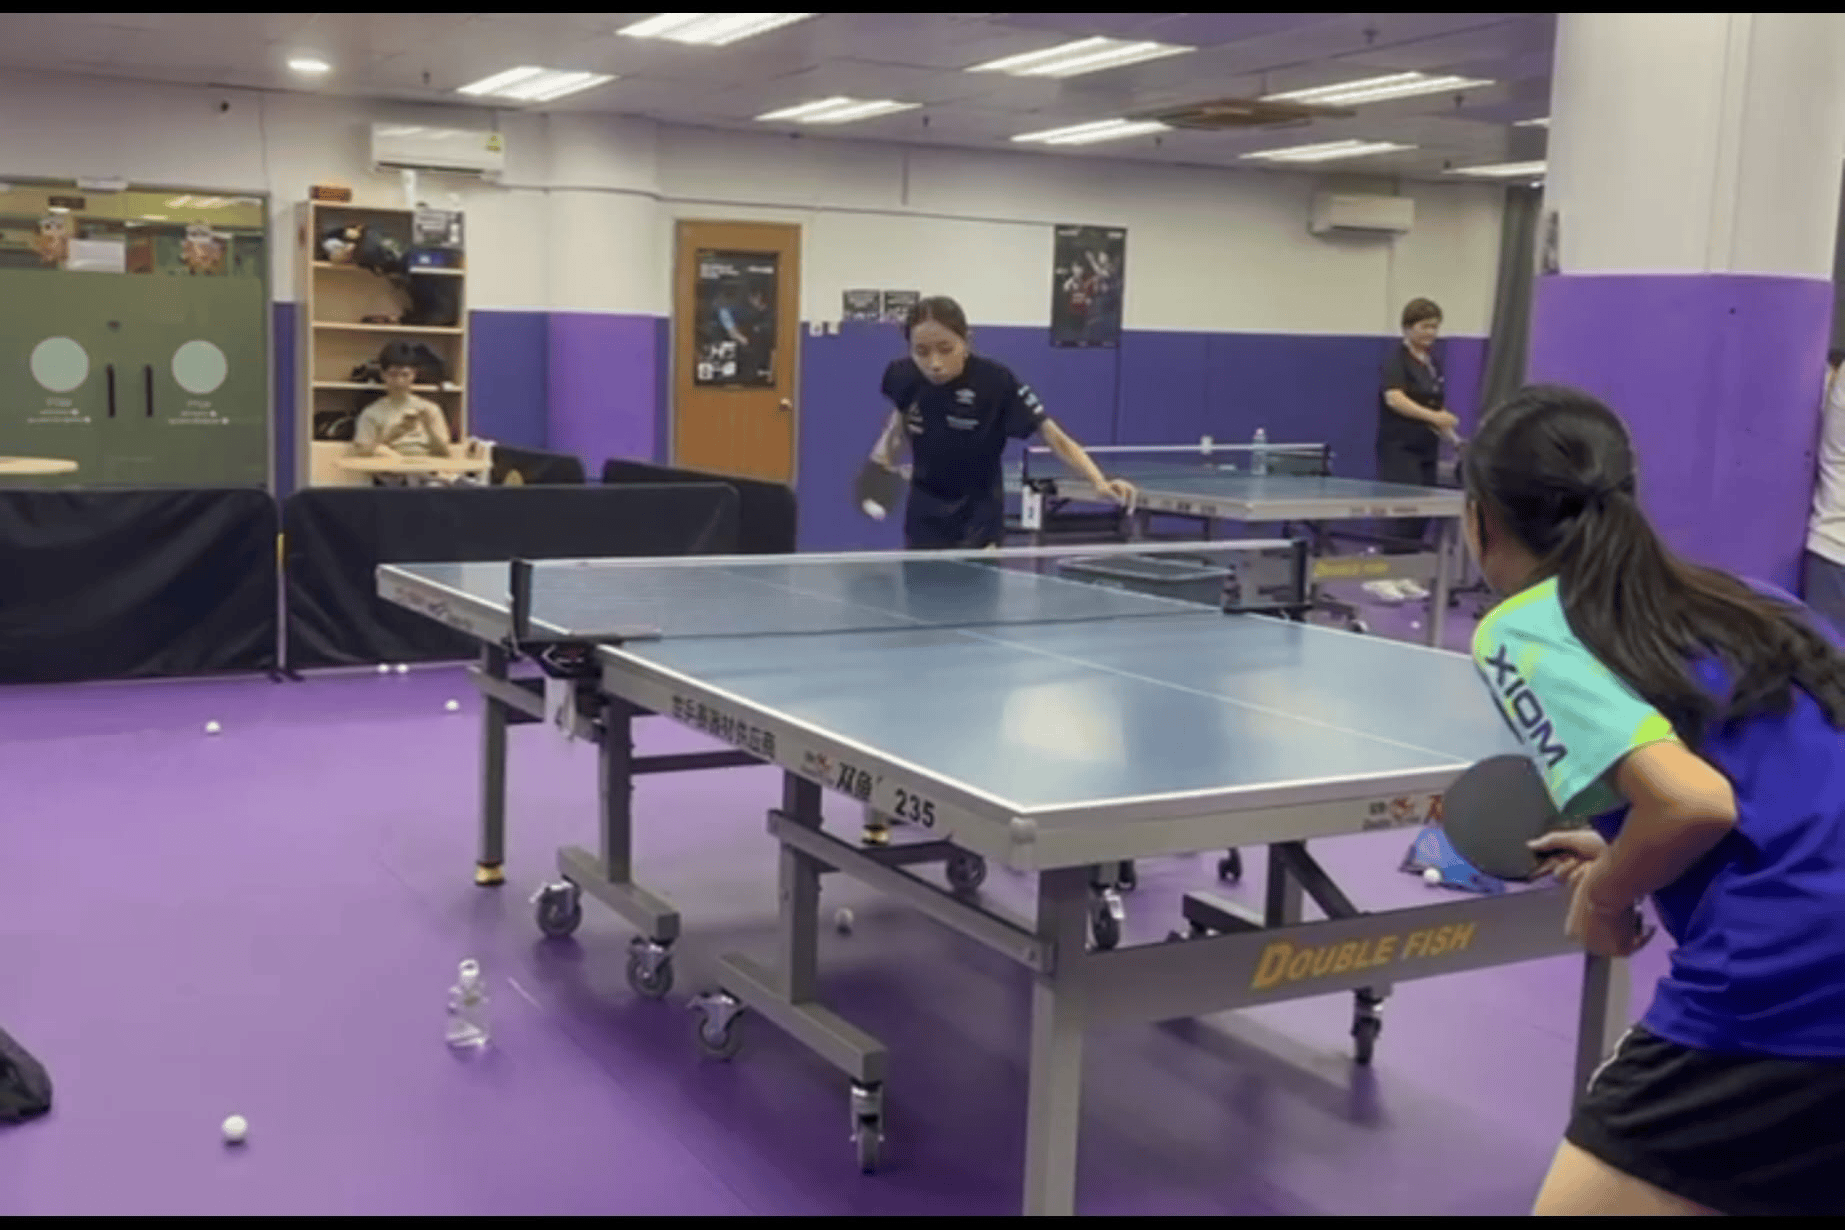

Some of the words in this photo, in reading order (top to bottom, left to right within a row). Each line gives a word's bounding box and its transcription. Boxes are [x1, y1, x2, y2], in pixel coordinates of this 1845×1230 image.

[1485, 645, 1568, 770] XIOM
[895, 788, 935, 828] 235
[1252, 935, 1399, 989] DOUBLE
[1402, 921, 1477, 960] FISH
